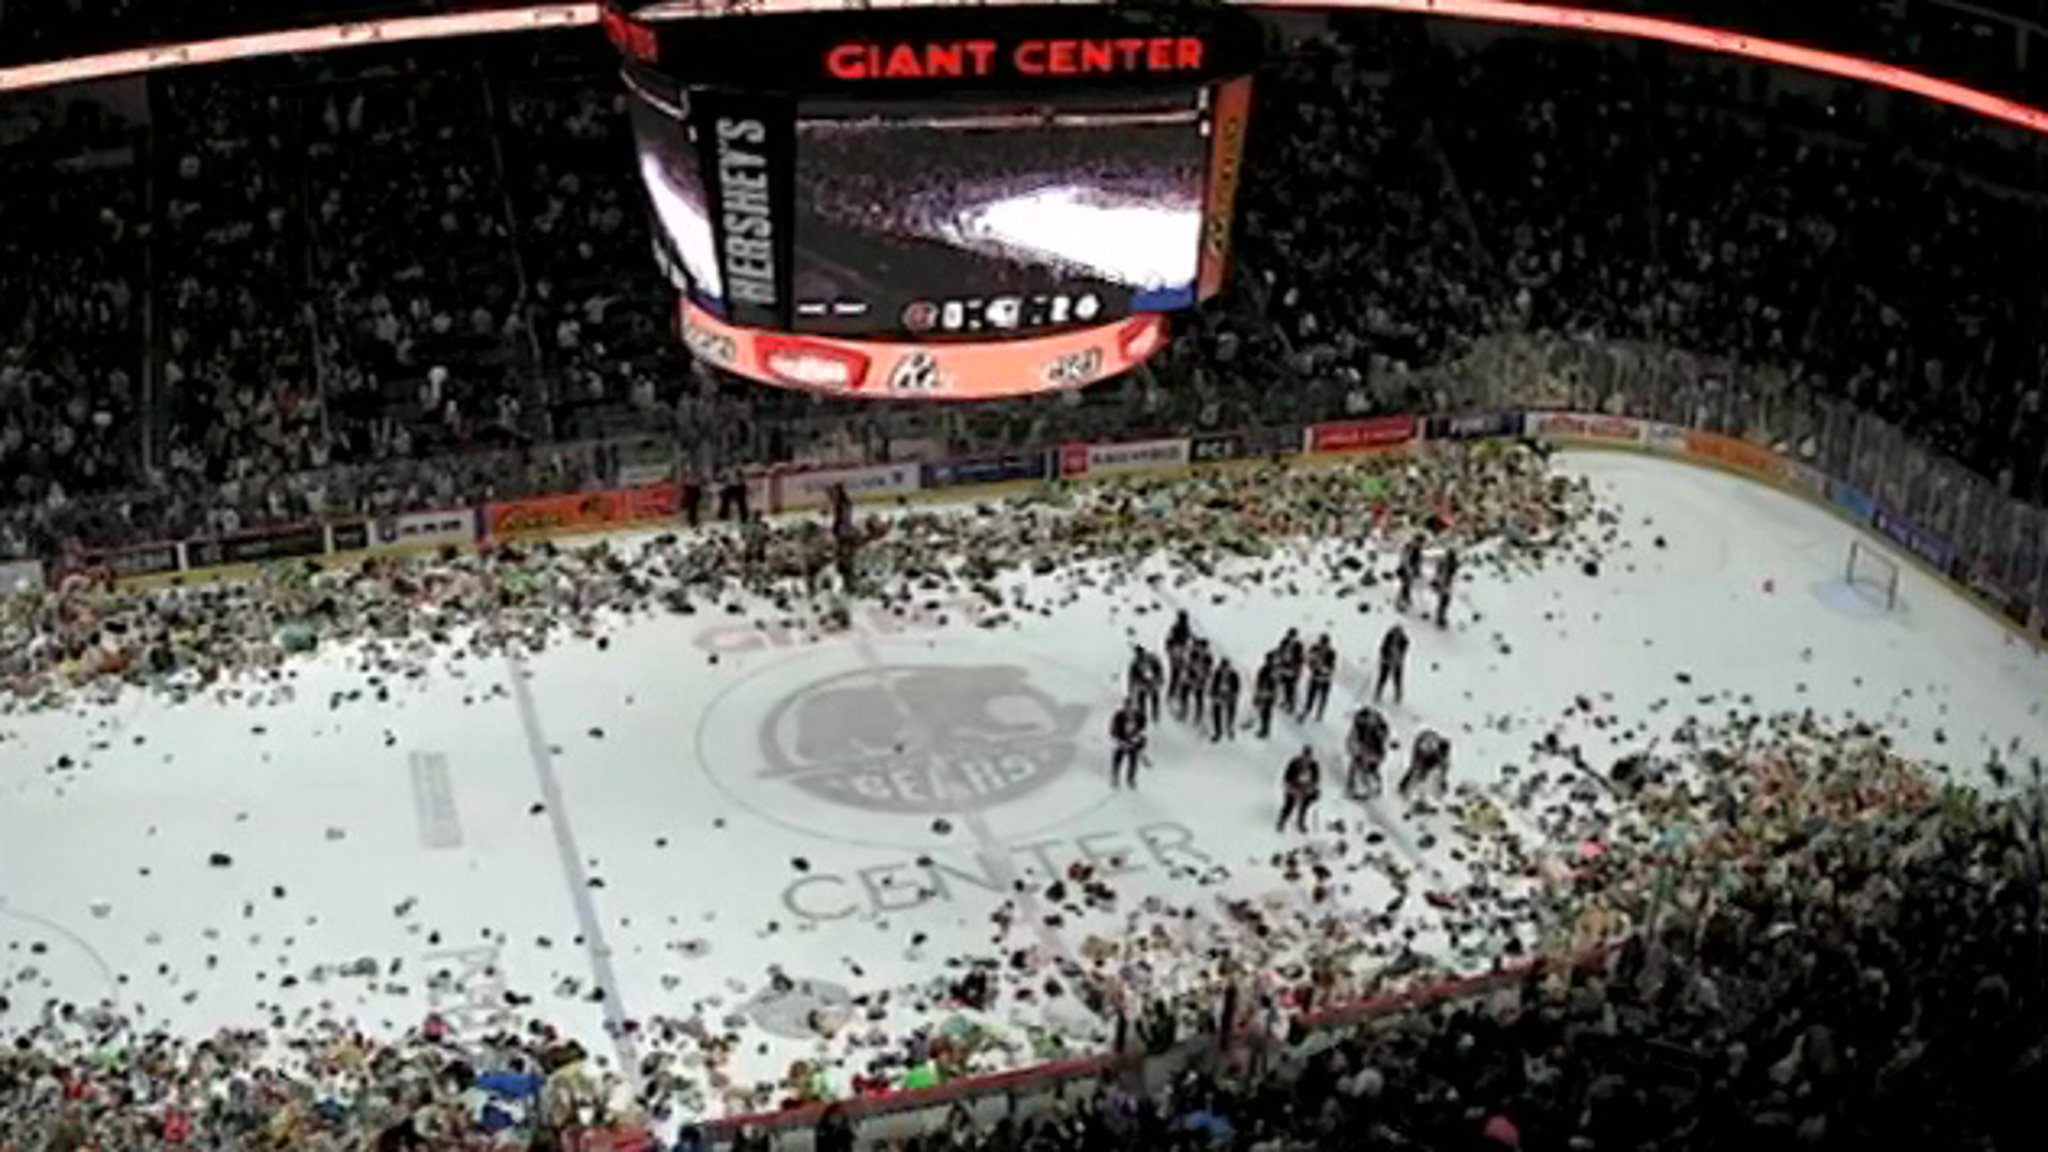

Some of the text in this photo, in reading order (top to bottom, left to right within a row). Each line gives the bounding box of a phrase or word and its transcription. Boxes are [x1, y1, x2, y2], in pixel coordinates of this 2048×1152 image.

[828, 37, 1203, 79] GIANT CENTER
[716, 117, 777, 304] HERSHEY'S
[848, 751, 1036, 801] BEARS
[783, 821, 1211, 921] CENTER
